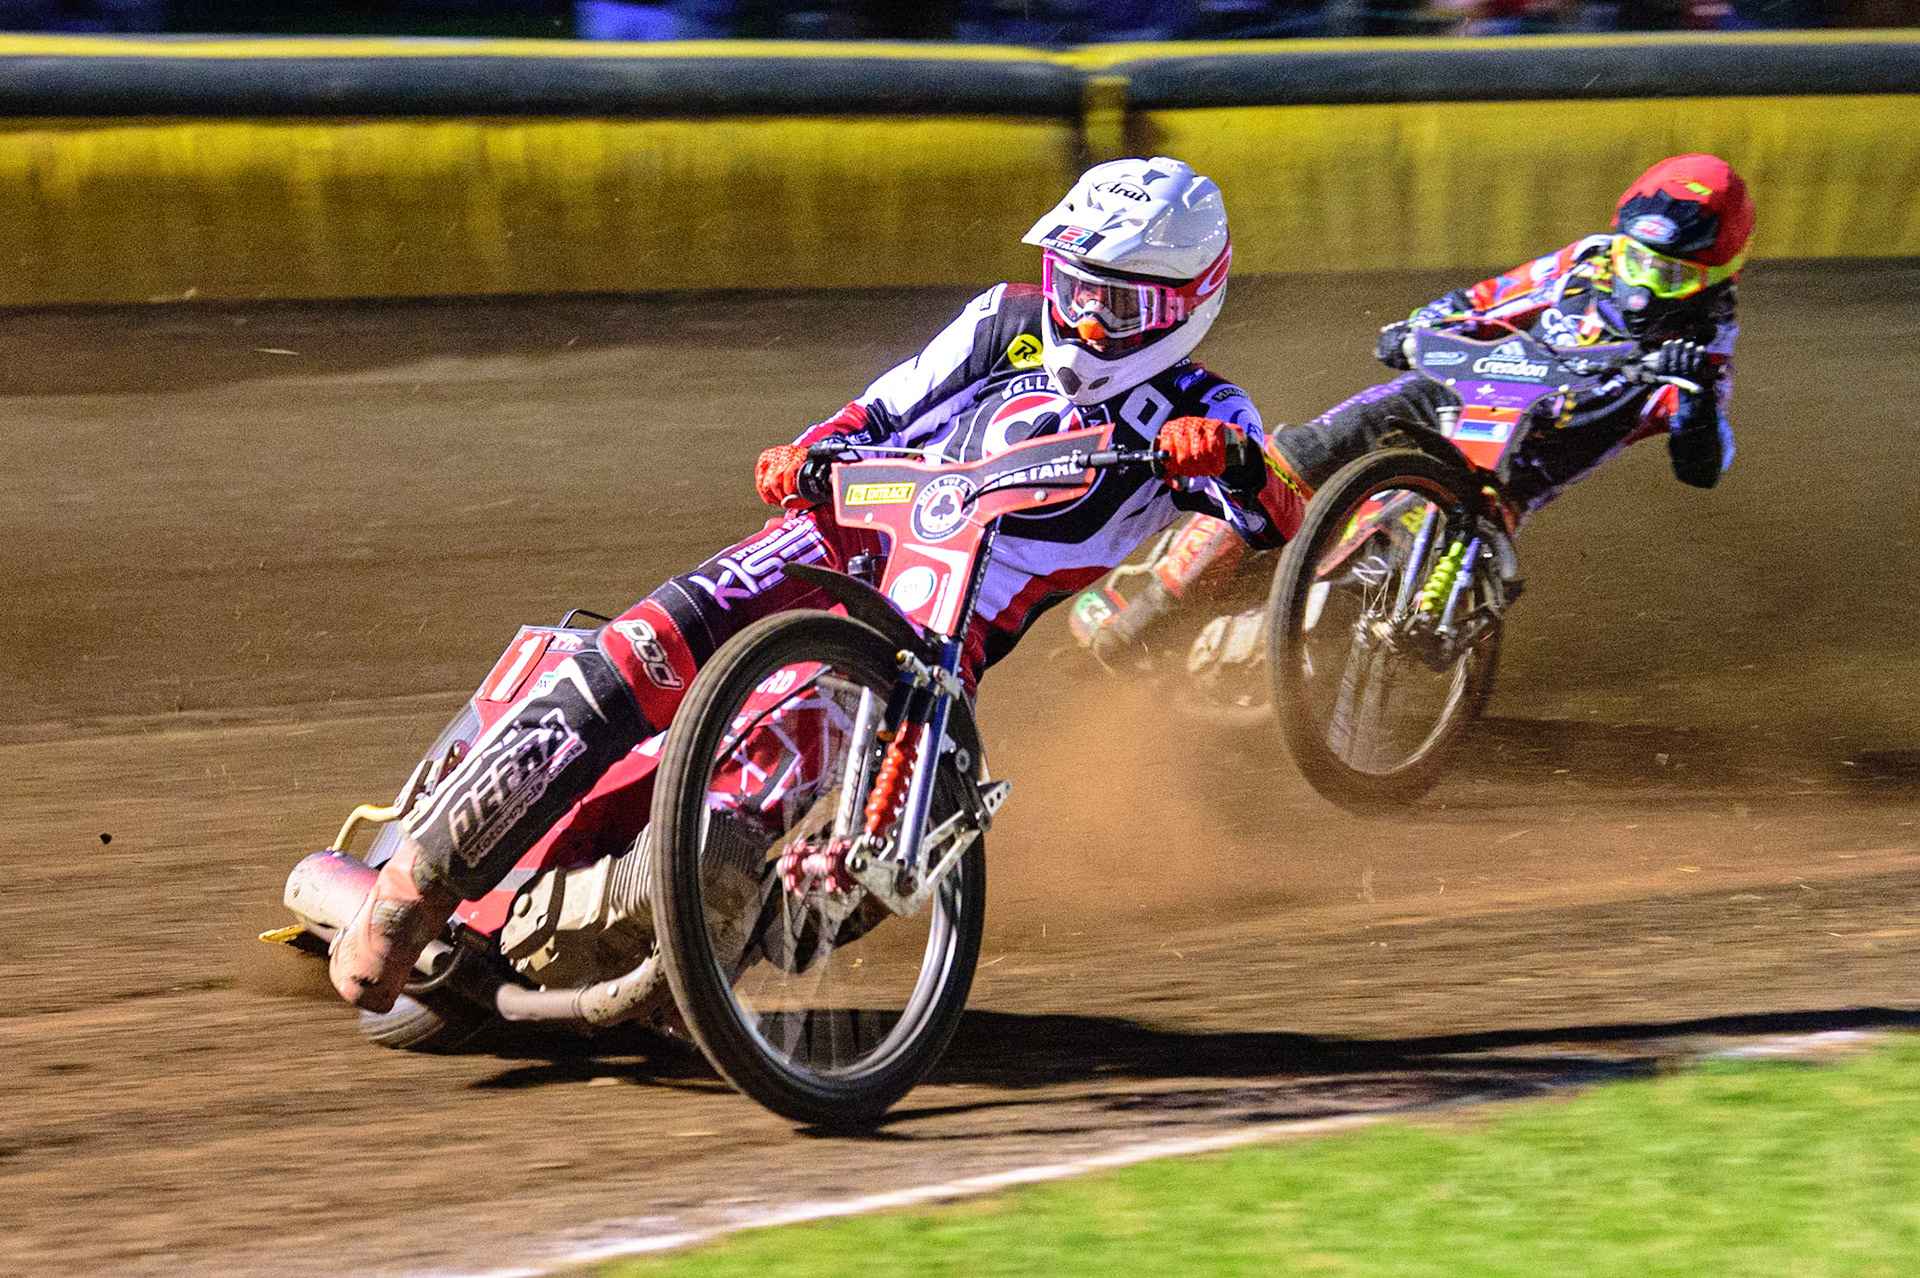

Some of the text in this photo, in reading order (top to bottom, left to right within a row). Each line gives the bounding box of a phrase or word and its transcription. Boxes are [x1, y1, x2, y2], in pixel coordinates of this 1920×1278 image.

[1100, 183, 1146, 202] Arai
[1473, 356, 1549, 378] Crendon
[491, 635, 543, 700] 1
